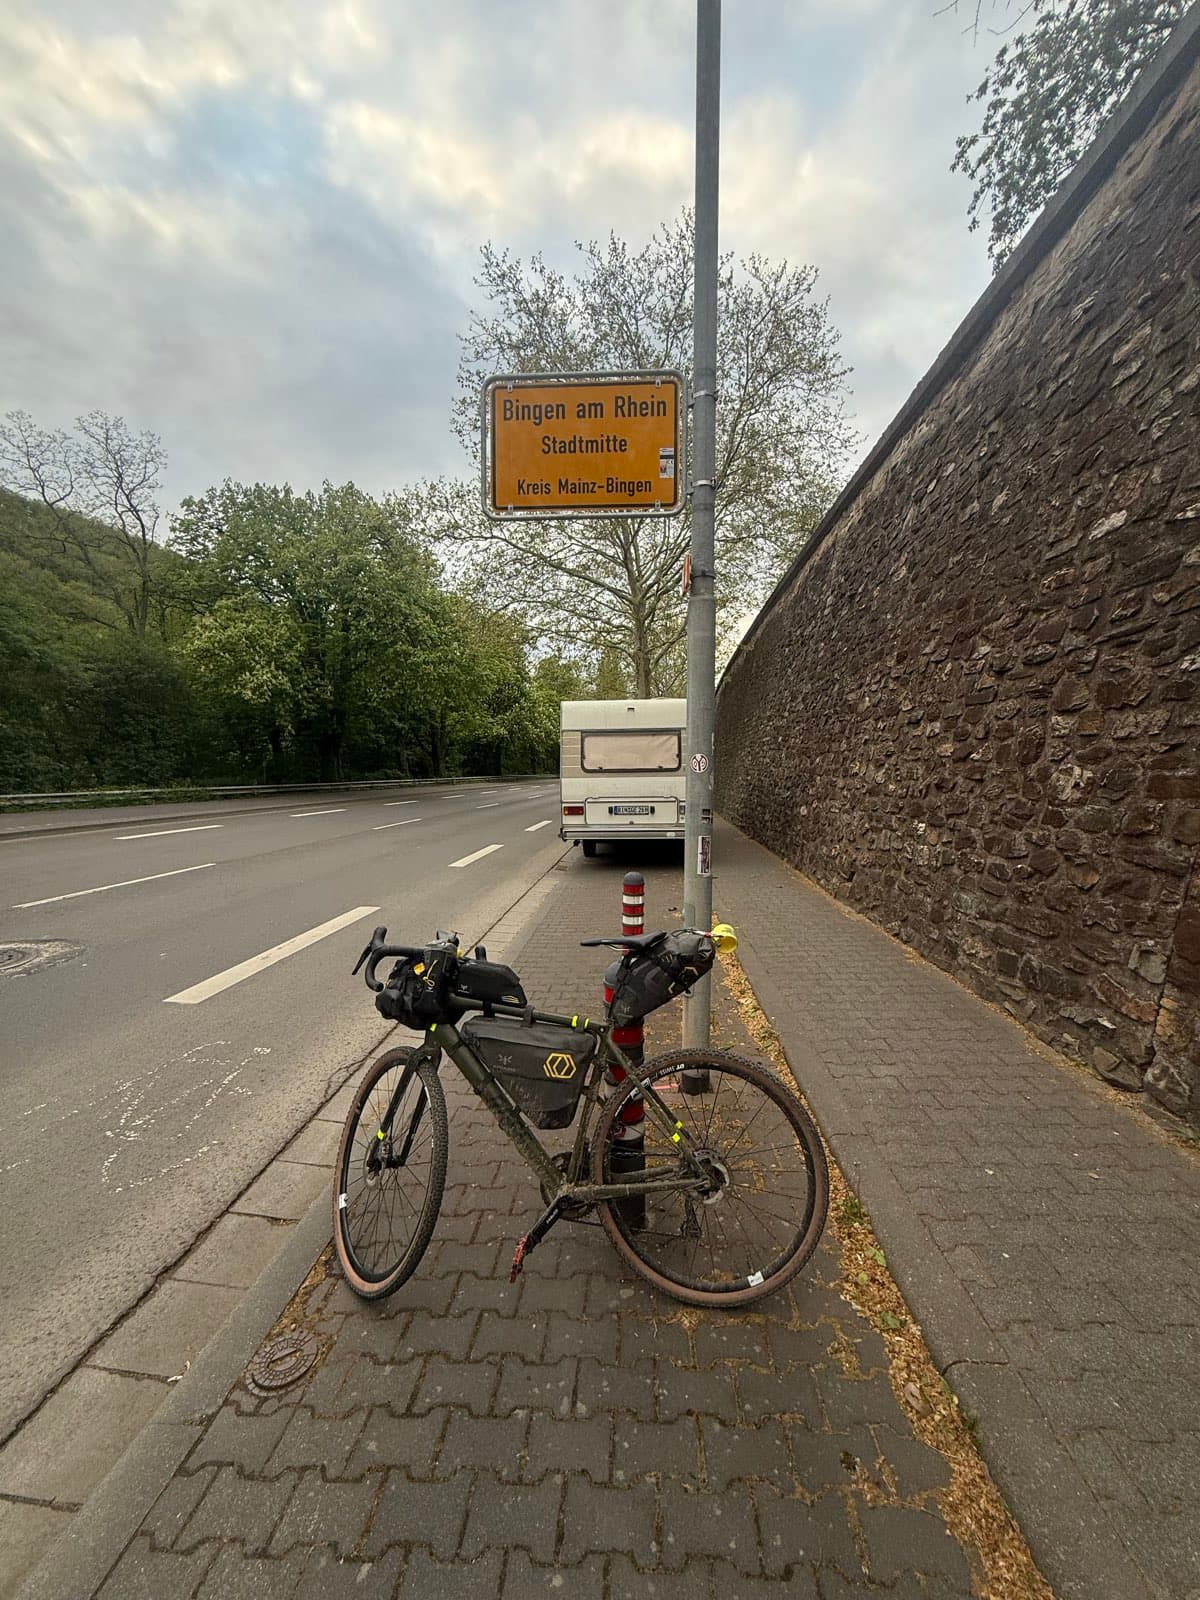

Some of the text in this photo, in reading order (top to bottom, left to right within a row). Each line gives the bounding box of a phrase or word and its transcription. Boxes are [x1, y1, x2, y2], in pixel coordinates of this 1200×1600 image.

[503, 394, 667, 426] Bingen am Rhein
[542, 434, 628, 454] Stadtmitte
[517, 477, 652, 496] Kreis Mainz-Bingen
